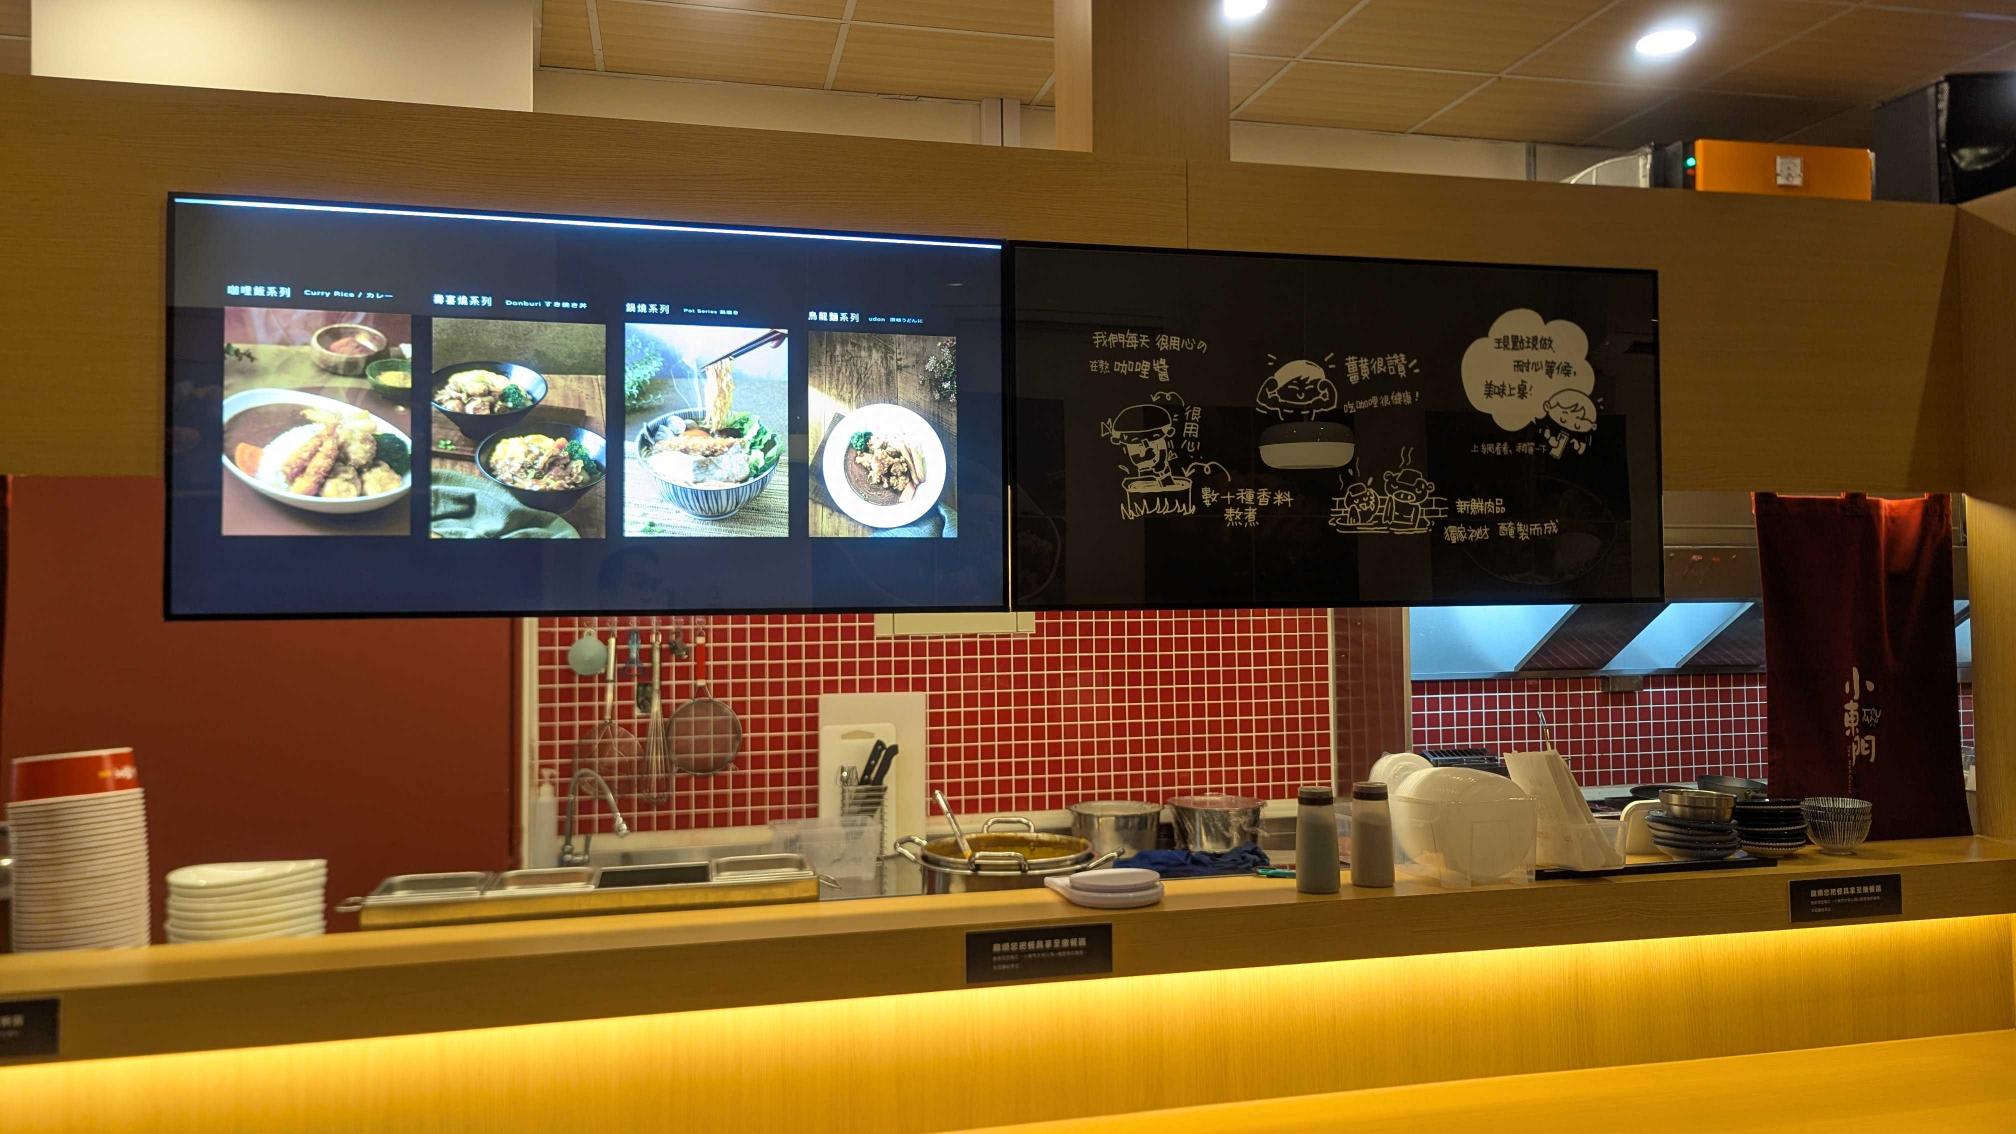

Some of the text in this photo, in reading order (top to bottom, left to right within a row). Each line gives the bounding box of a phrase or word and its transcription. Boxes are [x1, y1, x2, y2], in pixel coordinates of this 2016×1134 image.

[226, 285, 292, 299] 咖哩飯系列
[303, 289, 331, 298] Curry
[505, 299, 542, 307] Donburi
[625, 302, 670, 315] 鍋燒系列
[808, 311, 860, 323] 烏龍麵系列
[1201, 486, 1295, 508] 數十種香料
[1455, 497, 1506, 516] 新鮮肉品
[1223, 506, 1260, 528] 熬煮
[1844, 665, 1876, 768] 小東門
